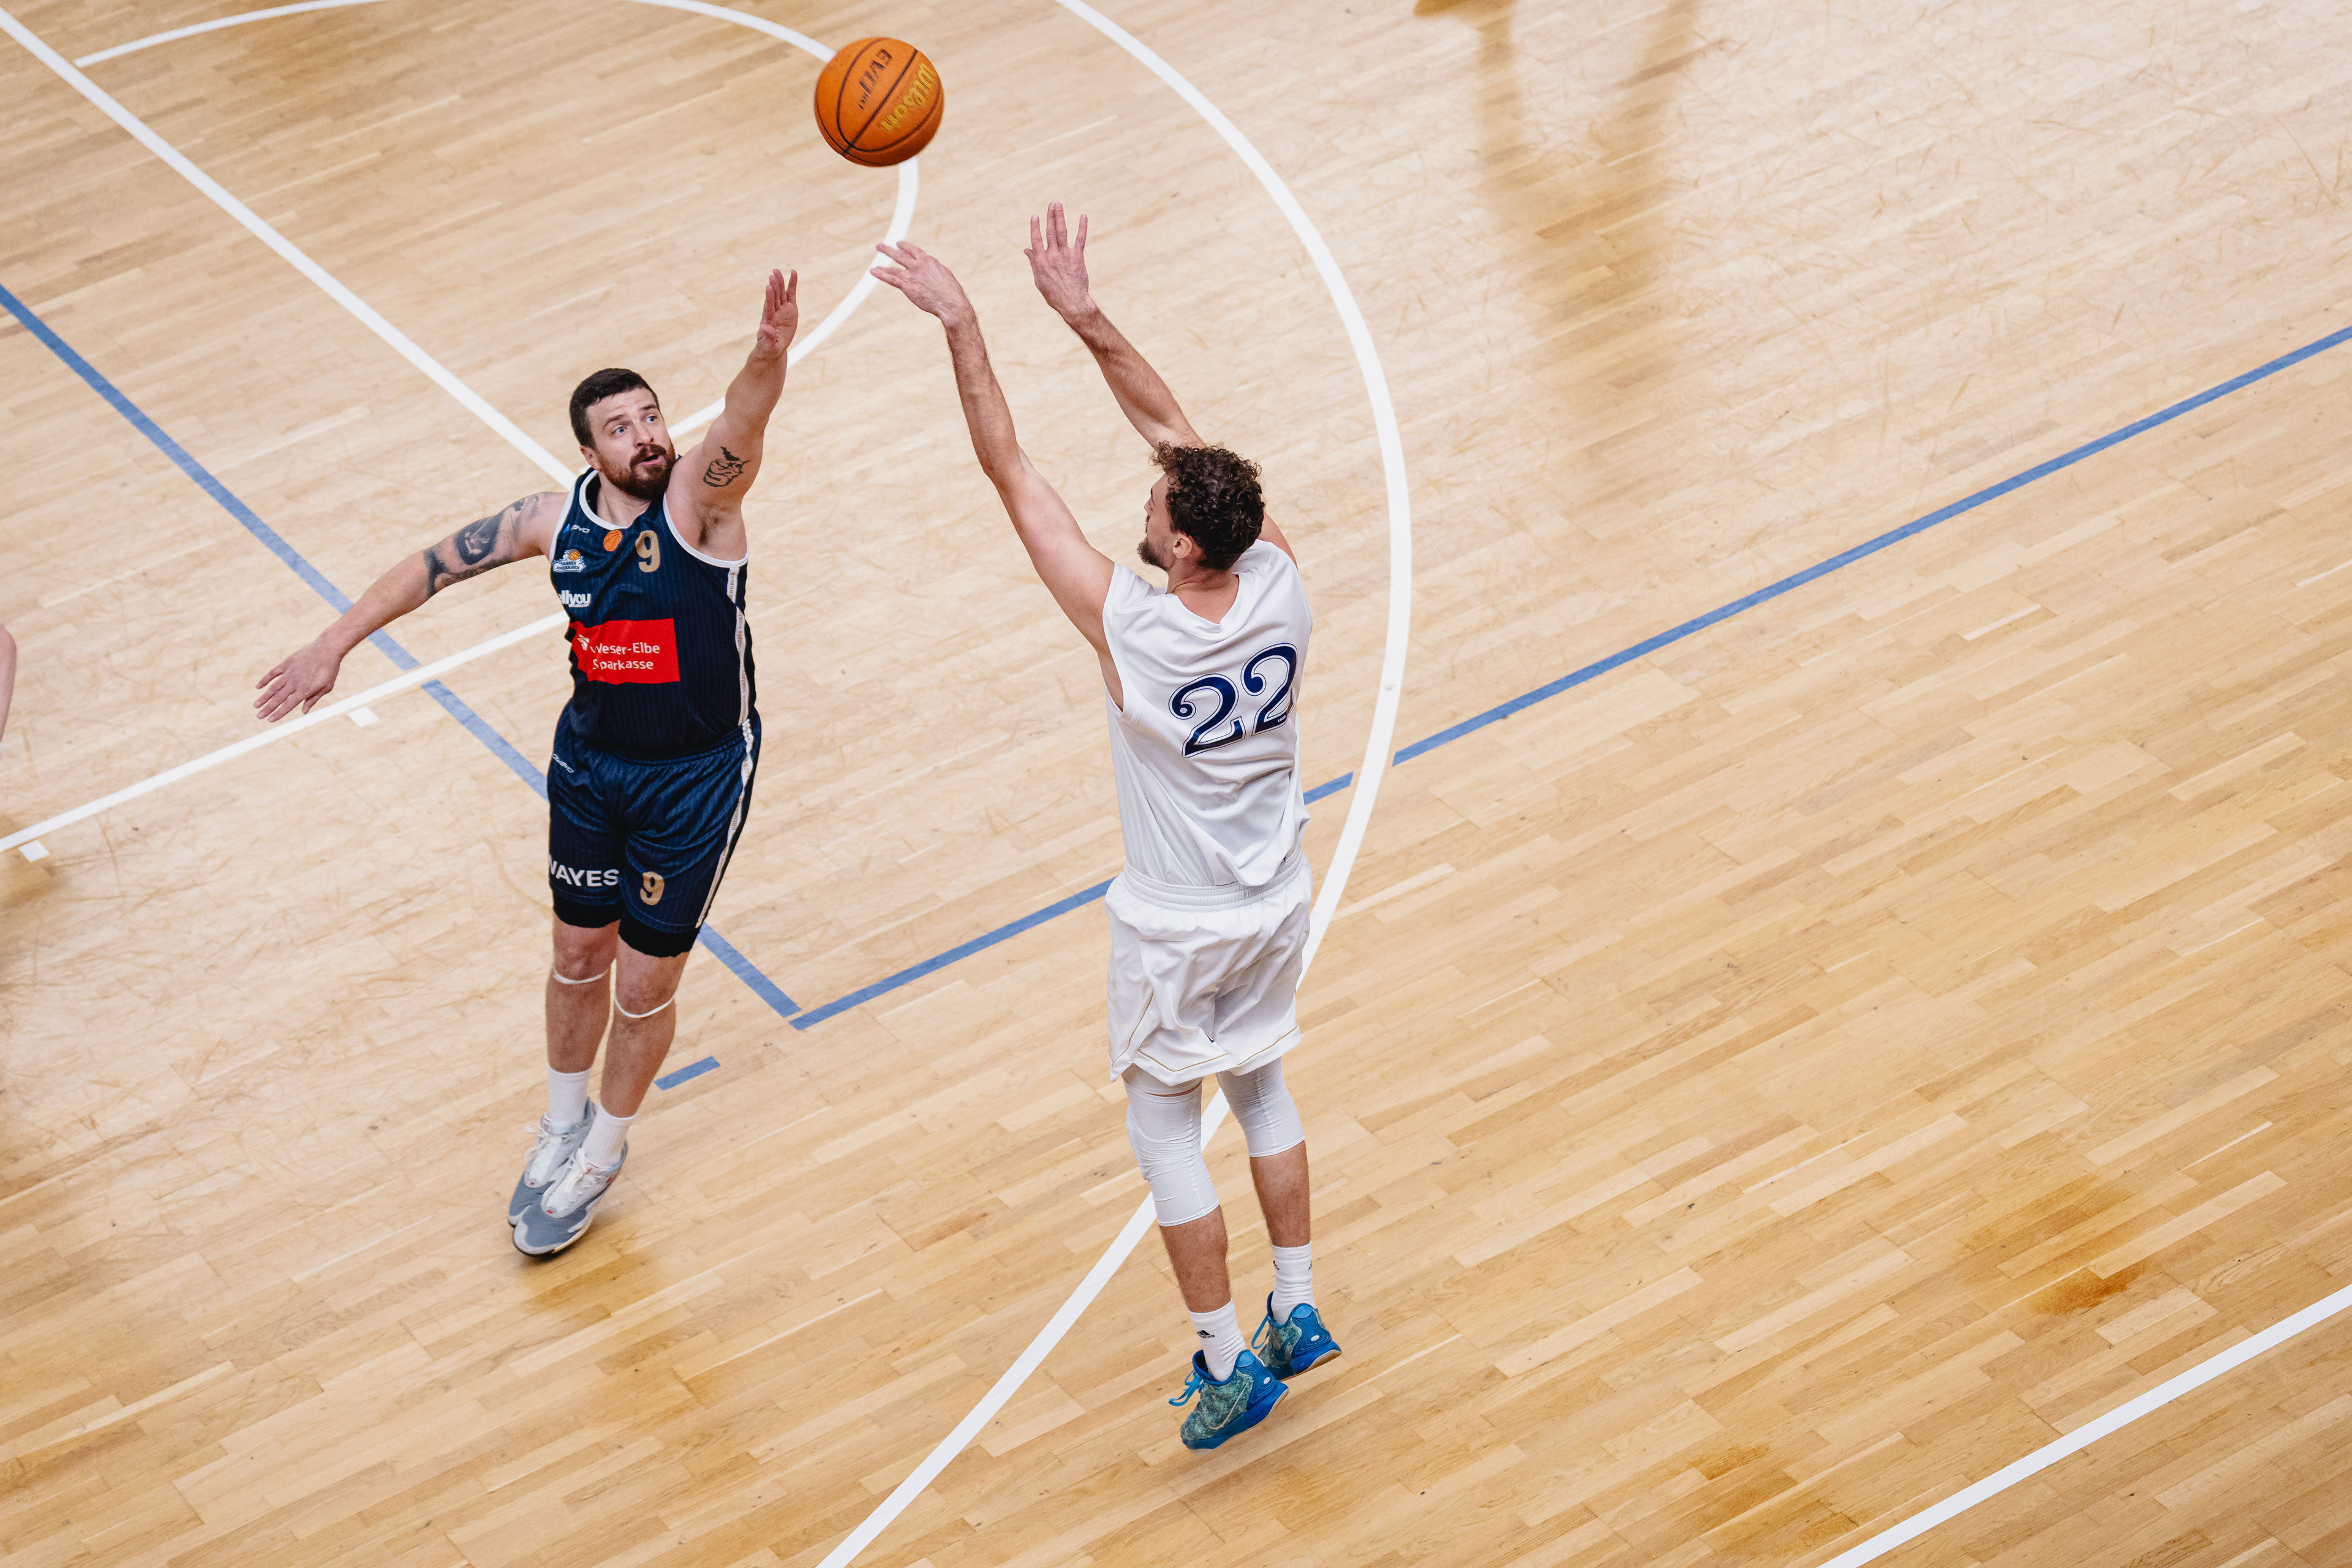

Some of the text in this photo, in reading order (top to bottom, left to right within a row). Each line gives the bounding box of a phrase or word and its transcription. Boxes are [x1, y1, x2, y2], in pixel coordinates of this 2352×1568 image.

[880, 62, 936, 132] Wilson
[635, 530, 661, 573] 9
[590, 641, 660, 655] Weser-Elbe
[592, 658, 654, 671] Sparkasse
[1168, 643, 1298, 758] 22
[639, 871, 665, 906] 9
